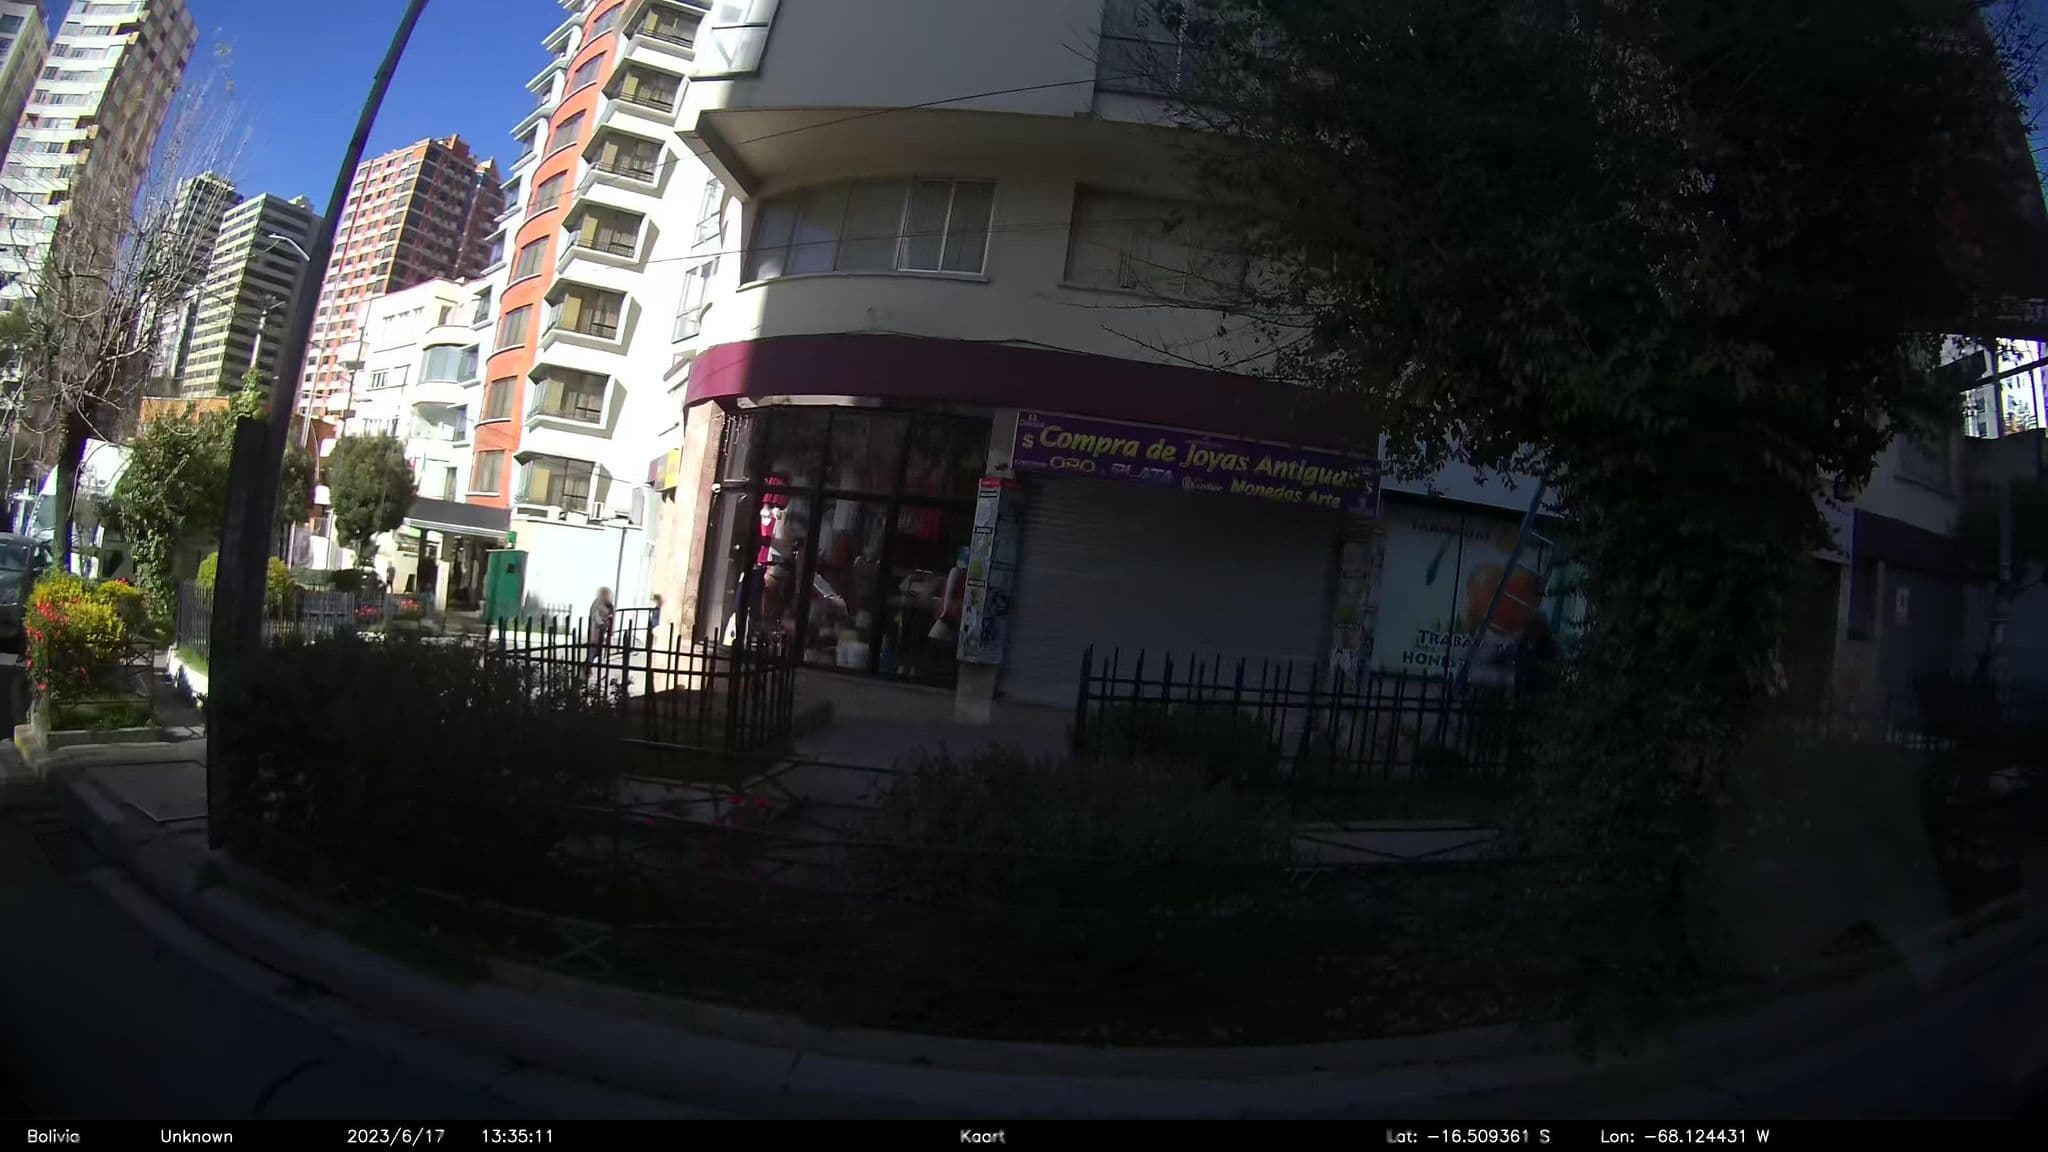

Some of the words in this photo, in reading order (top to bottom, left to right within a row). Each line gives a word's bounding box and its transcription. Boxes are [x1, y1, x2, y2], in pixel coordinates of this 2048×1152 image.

[1039, 425, 1141, 458] Compra
[1145, 438, 1177, 462] de
[1179, 443, 1250, 473] Joyas
[1050, 455, 1096, 473] ORO
[1306, 490, 1342, 509] Arte
